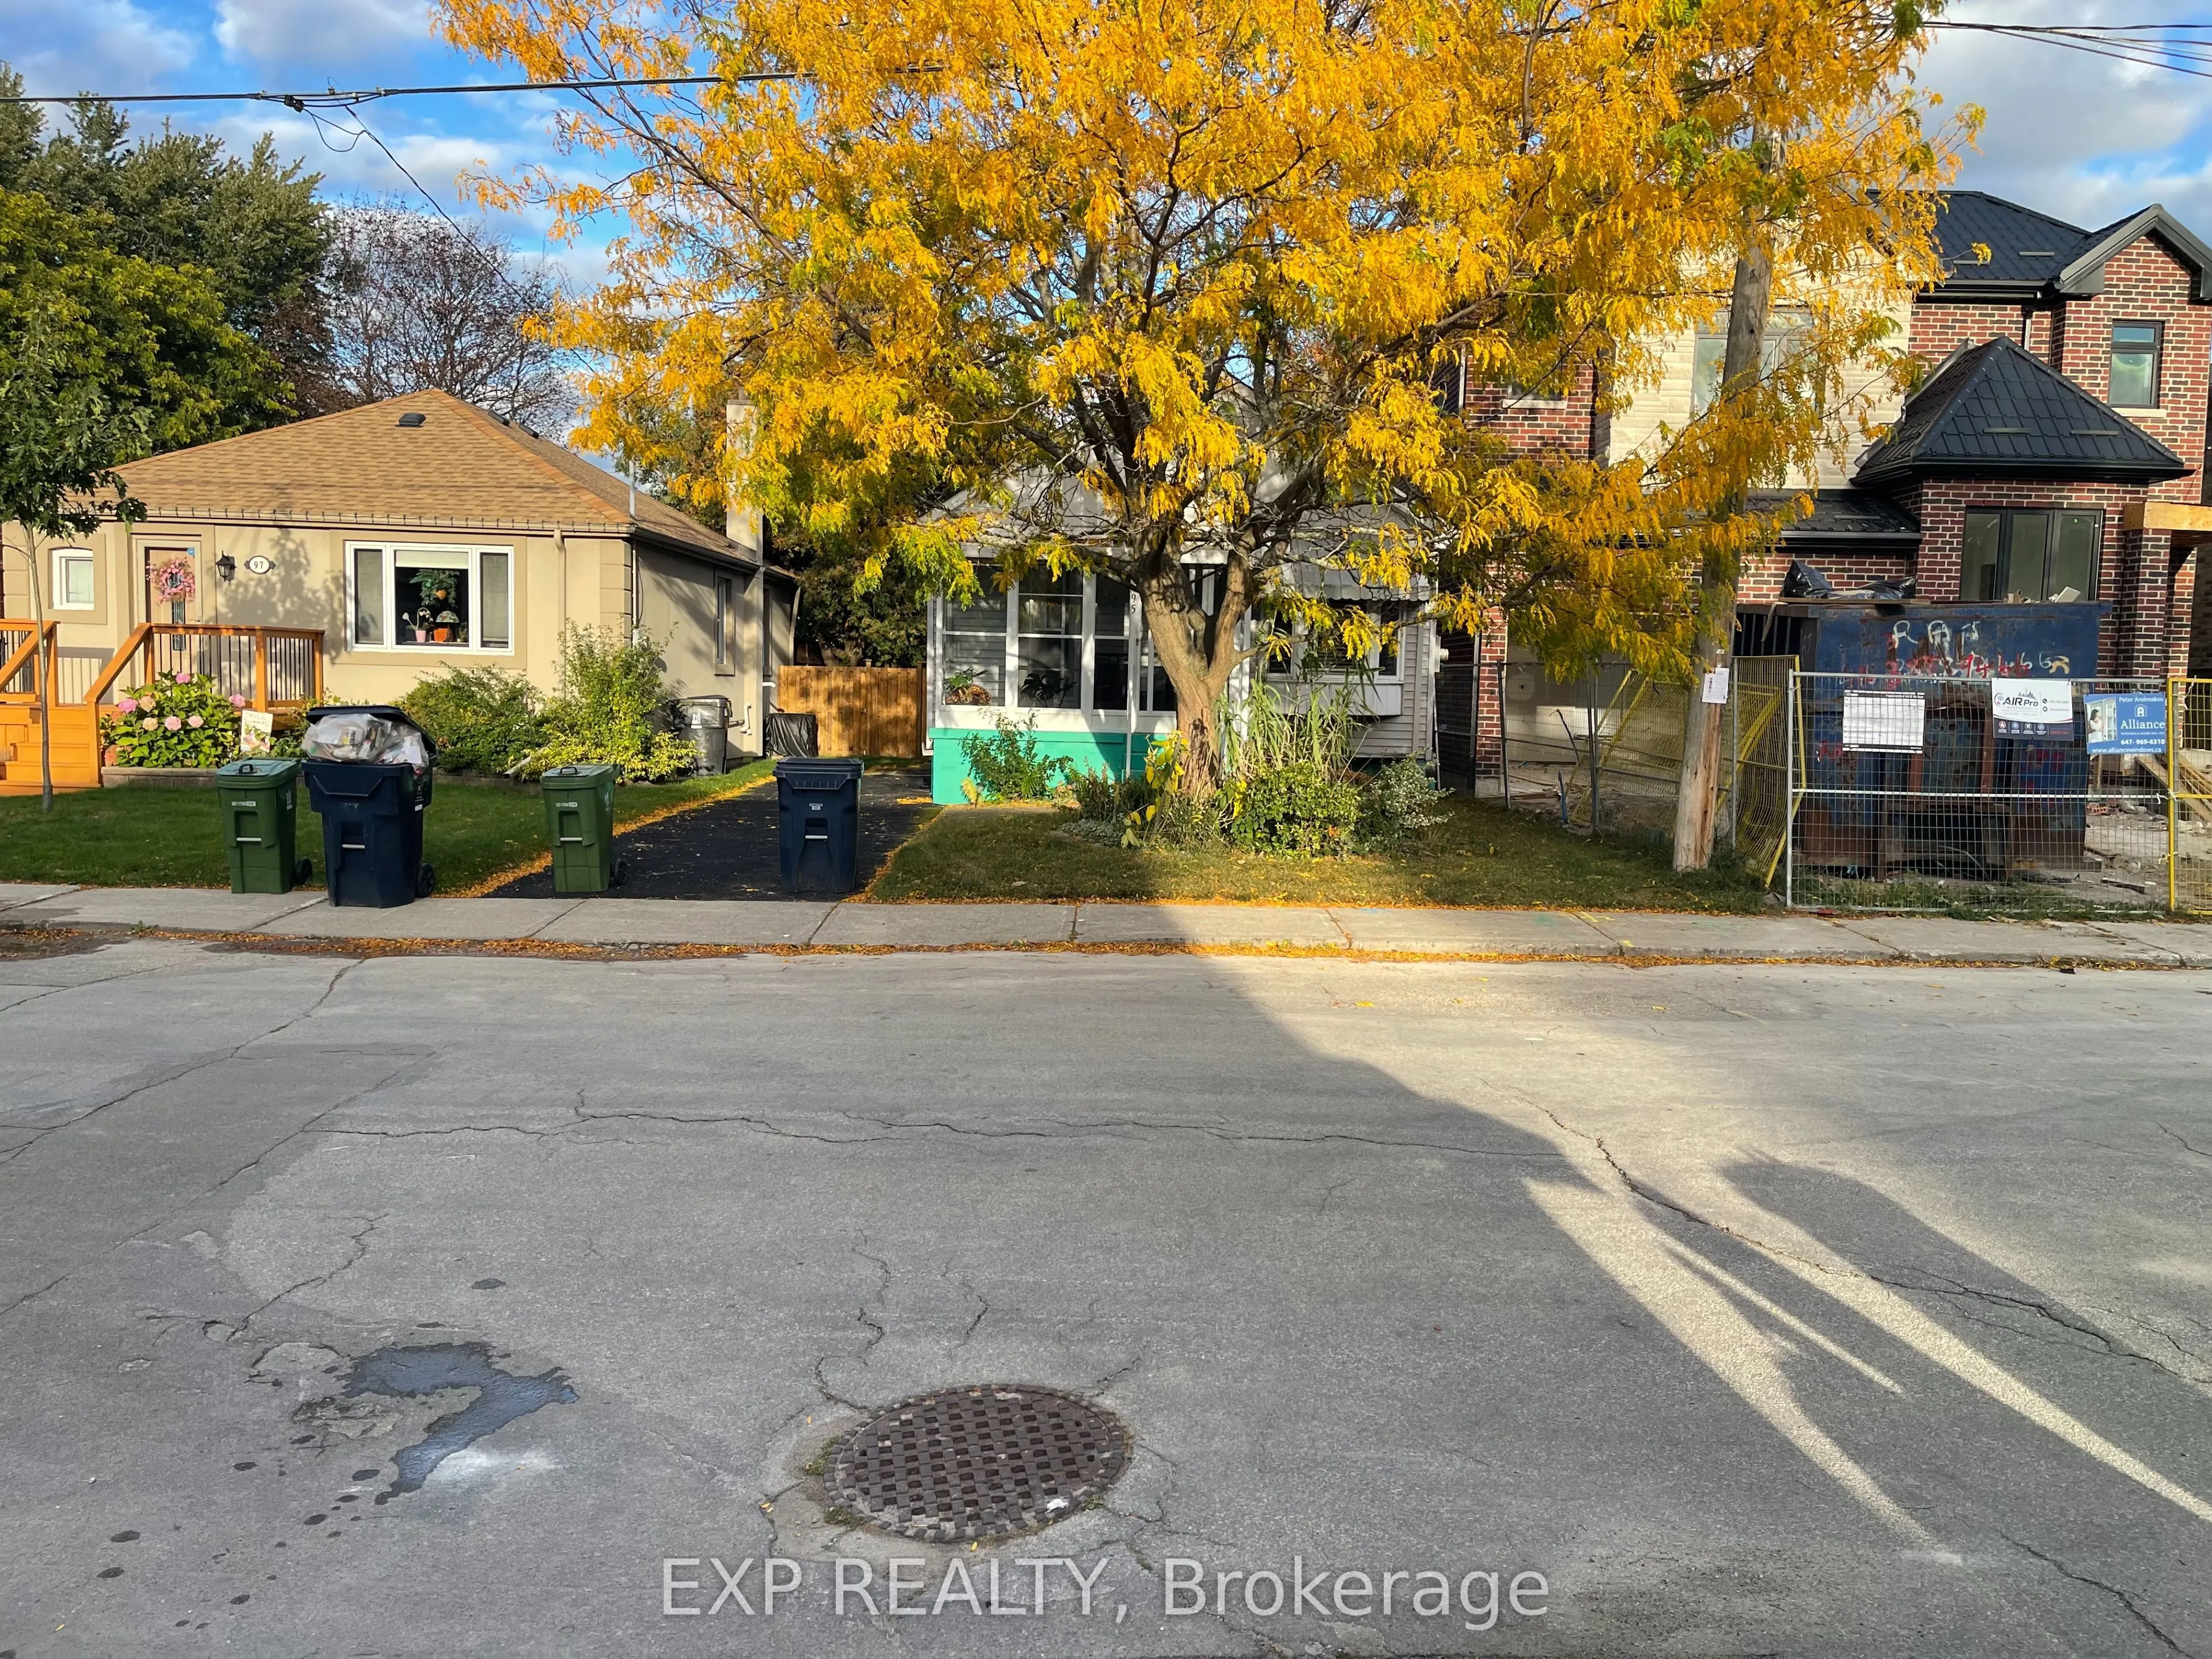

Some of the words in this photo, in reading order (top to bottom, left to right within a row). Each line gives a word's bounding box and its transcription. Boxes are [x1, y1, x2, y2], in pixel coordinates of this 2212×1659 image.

[254, 561, 264, 569] 97
[1131, 593, 1136, 615] 95
[2003, 697, 2022, 706] AIR
[2120, 719, 2165, 729] Alliance
